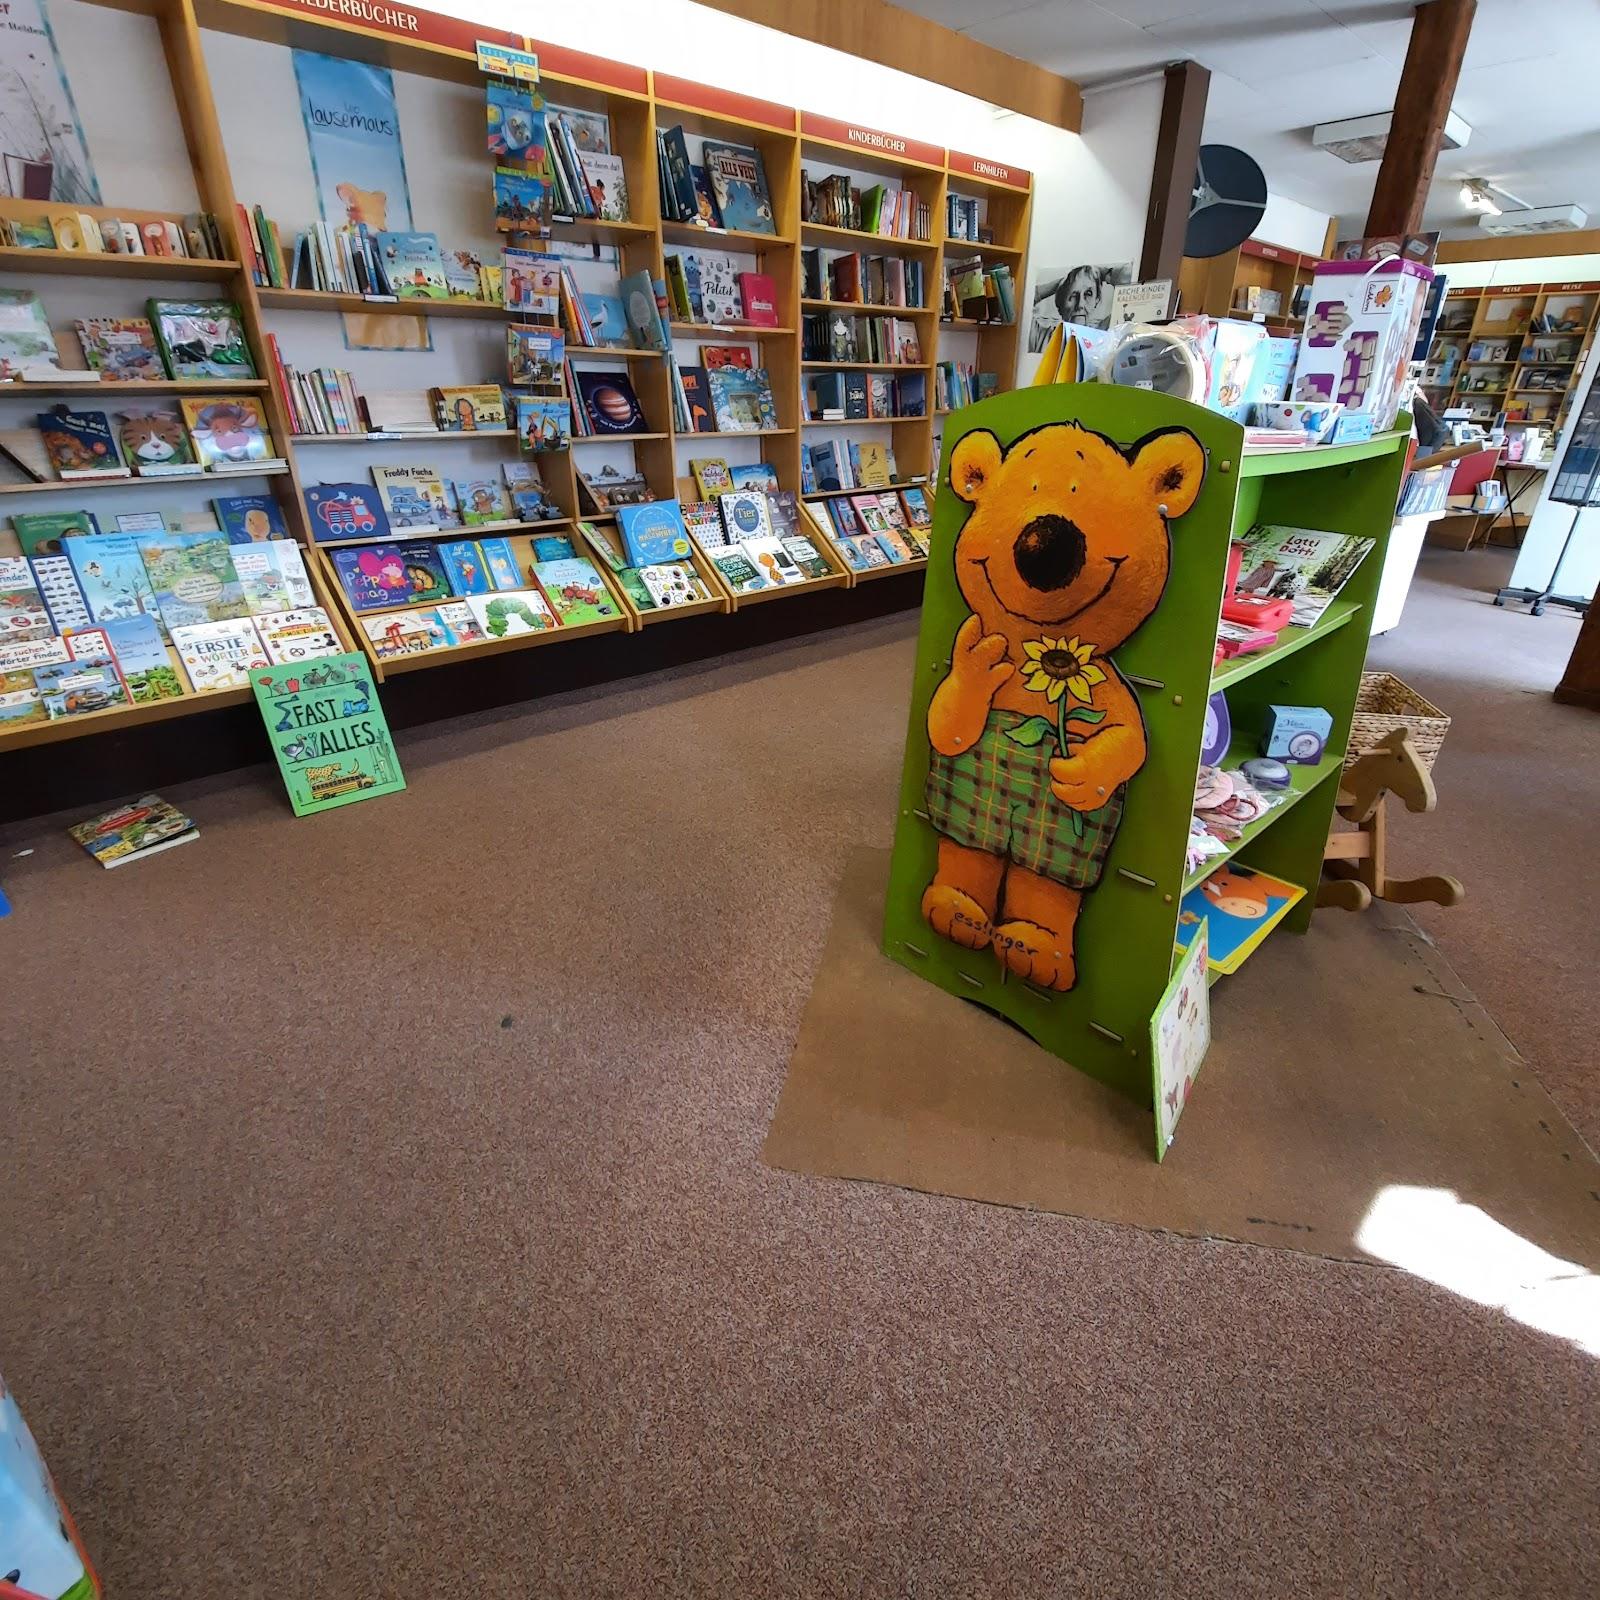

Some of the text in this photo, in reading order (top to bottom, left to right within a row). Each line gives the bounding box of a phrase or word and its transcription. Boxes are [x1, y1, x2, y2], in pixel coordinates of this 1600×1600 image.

[289, 0, 418, 31] LDERBÜCHER
[848, 128, 906, 153] KINDERBÜCHER
[973, 160, 1008, 179] LERNHILFEN
[383, 467, 433, 478] Freddy Fuchs
[735, 507, 756, 519] Tier
[1286, 535, 1321, 547] Lotti
[1279, 544, 1315, 557] Dotti
[14, 646, 45, 656] suchen
[195, 637, 245, 654] ERSTE
[0, 650, 63, 666] Wörter finden
[200, 650, 249, 664] WÖRTER
[292, 699, 339, 728] FAST
[319, 721, 376, 756] ALLES
